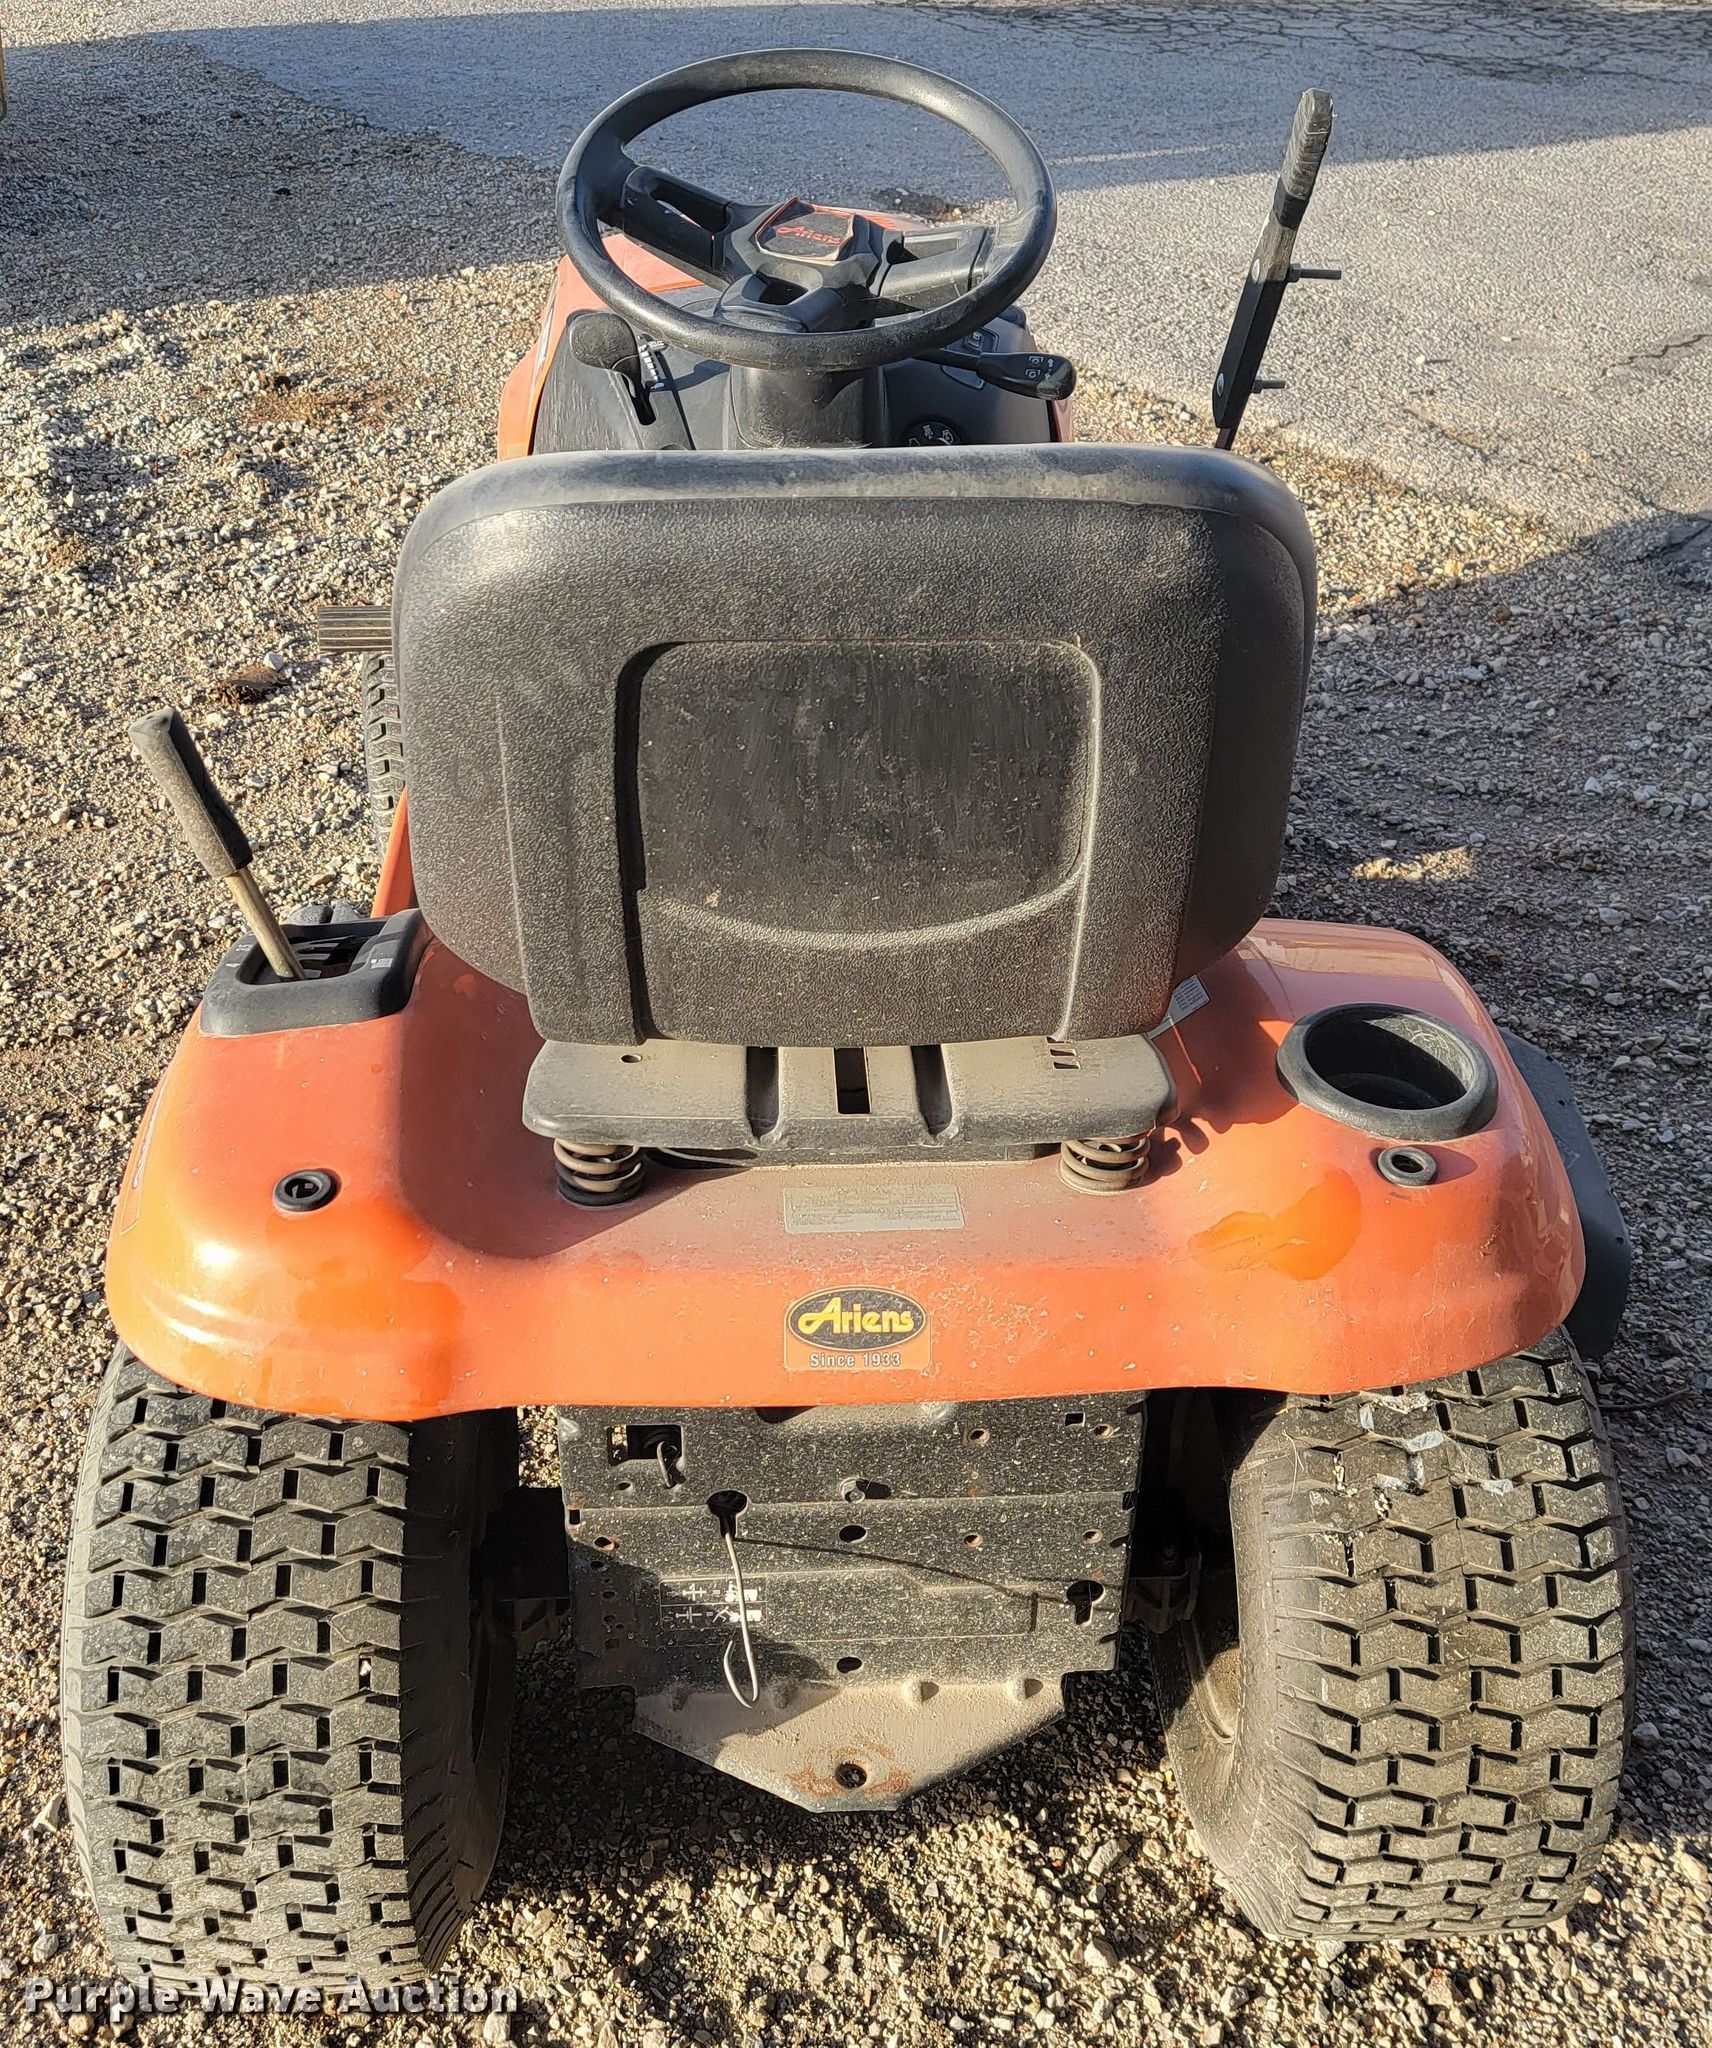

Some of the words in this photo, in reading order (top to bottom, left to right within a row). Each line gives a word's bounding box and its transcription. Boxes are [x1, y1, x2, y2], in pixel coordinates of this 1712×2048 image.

[777, 225, 842, 244] Ariens
[798, 1296, 914, 1334] Ariens
[810, 1353, 855, 1367] Since
[863, 1352, 902, 1366] 1933
